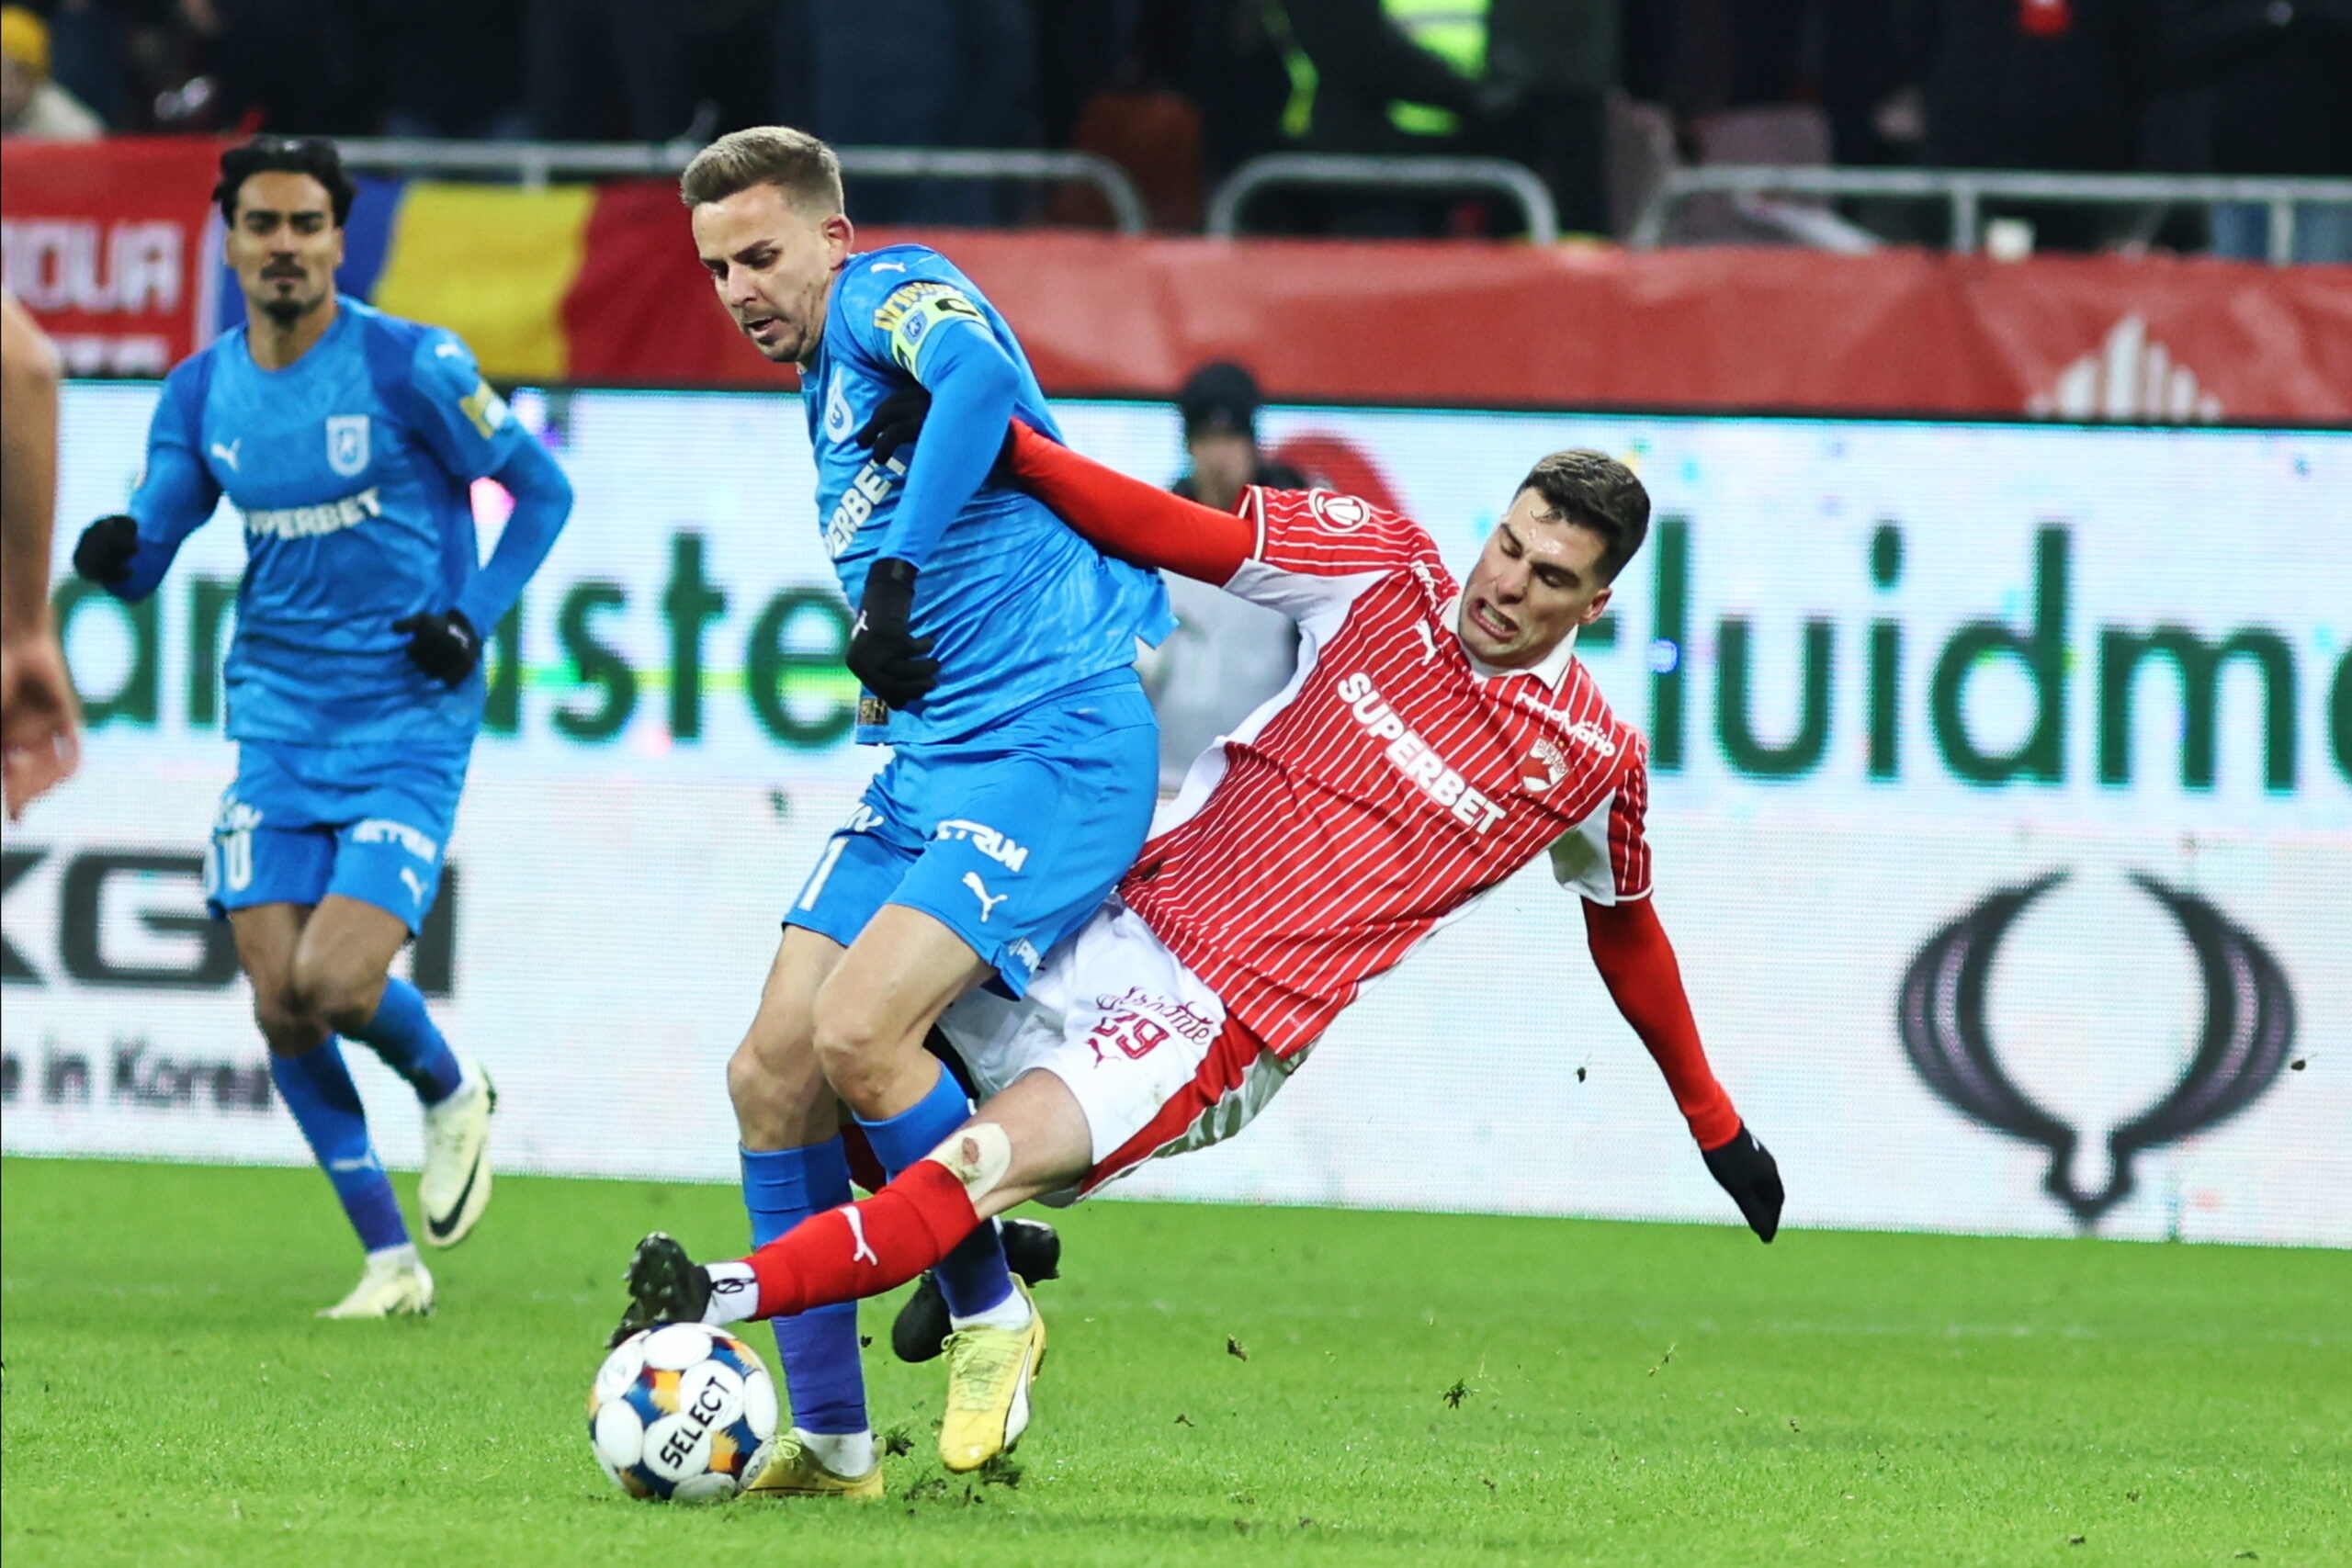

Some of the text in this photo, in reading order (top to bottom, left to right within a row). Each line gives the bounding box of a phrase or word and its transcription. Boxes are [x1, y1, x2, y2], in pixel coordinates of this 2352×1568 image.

[0, 219, 182, 314] OUA
[1575, 516, 2352, 795] luidm
[1337, 671, 1507, 835] SUPERBET
[1515, 692, 1616, 757] renovatio
[660, 1376, 730, 1470] SELECT
